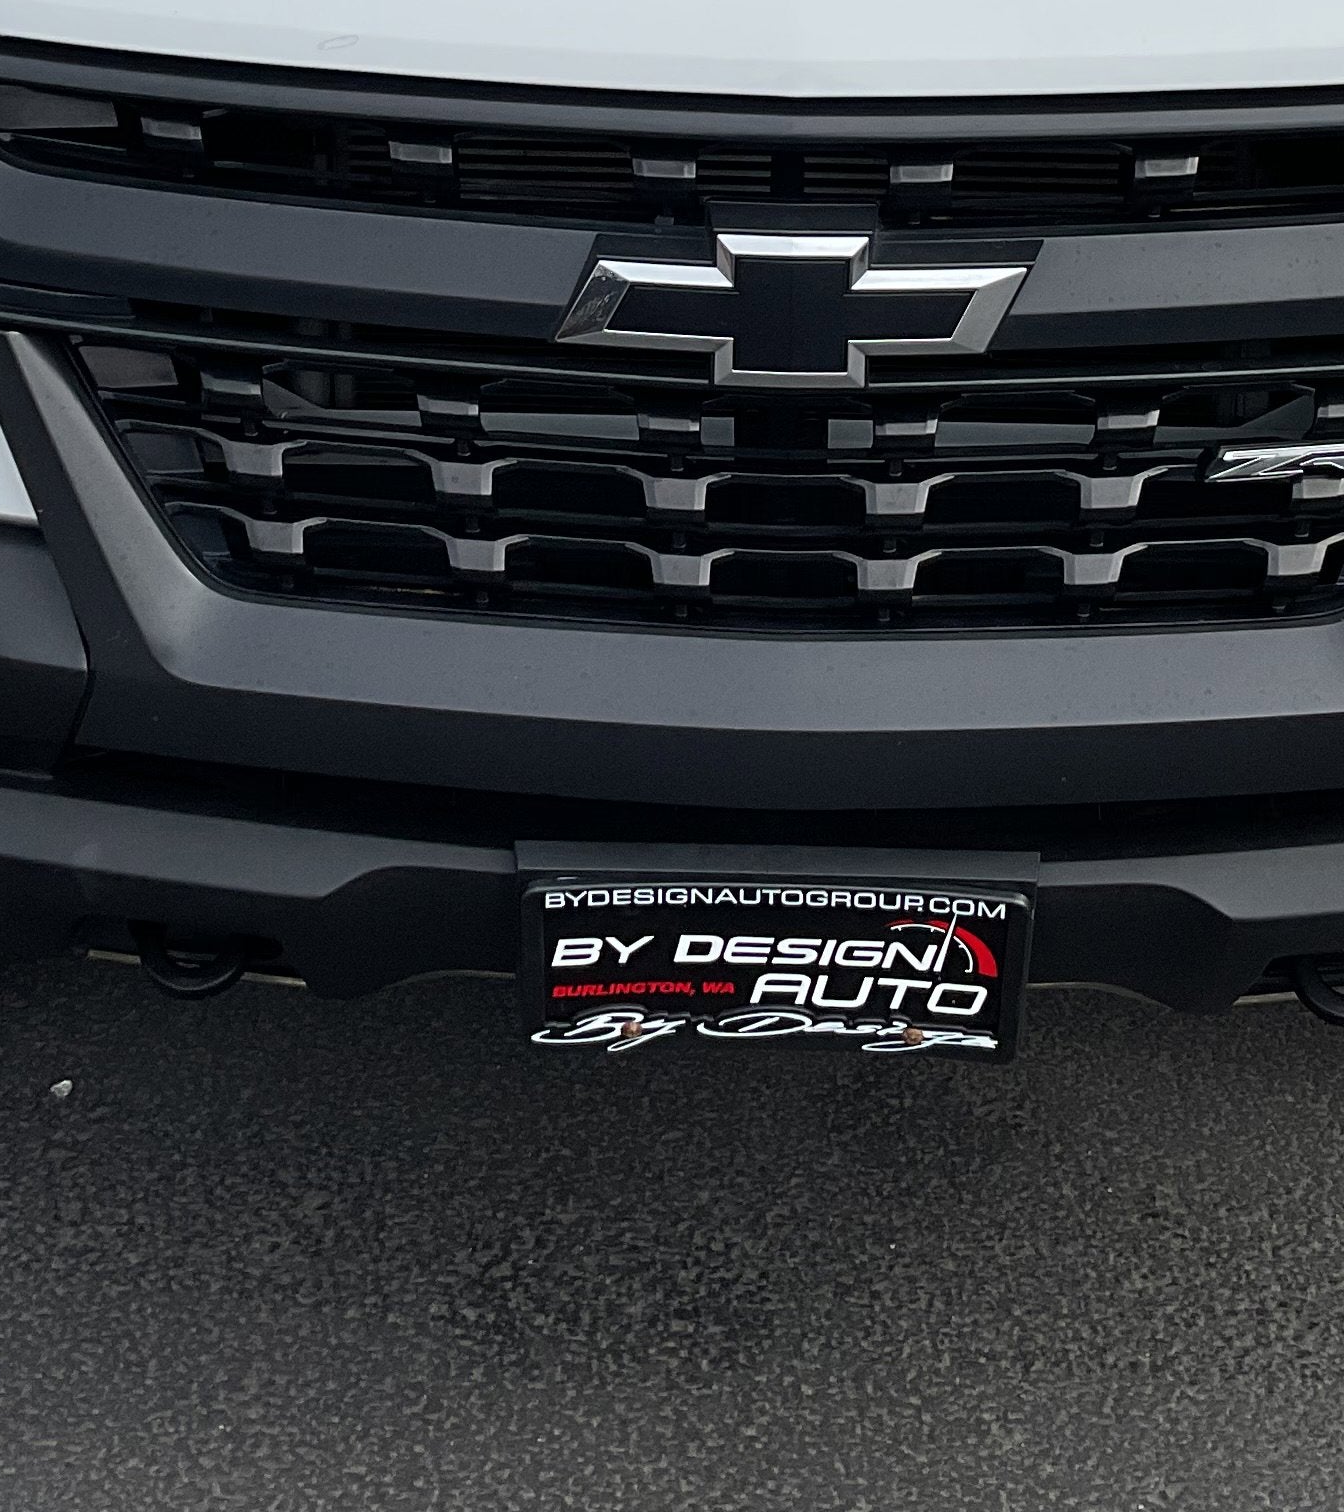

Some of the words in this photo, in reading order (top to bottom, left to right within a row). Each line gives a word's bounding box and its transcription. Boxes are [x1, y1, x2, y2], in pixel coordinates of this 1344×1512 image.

[544, 888, 1007, 920] BYDESIGNAUTOGROUP.COM
[551, 935, 655, 967] BY
[673, 934, 939, 973] DESIGN
[552, 981, 697, 998] BURLINGTON,
[702, 981, 736, 994] WA
[749, 973, 988, 1016] AUTO
